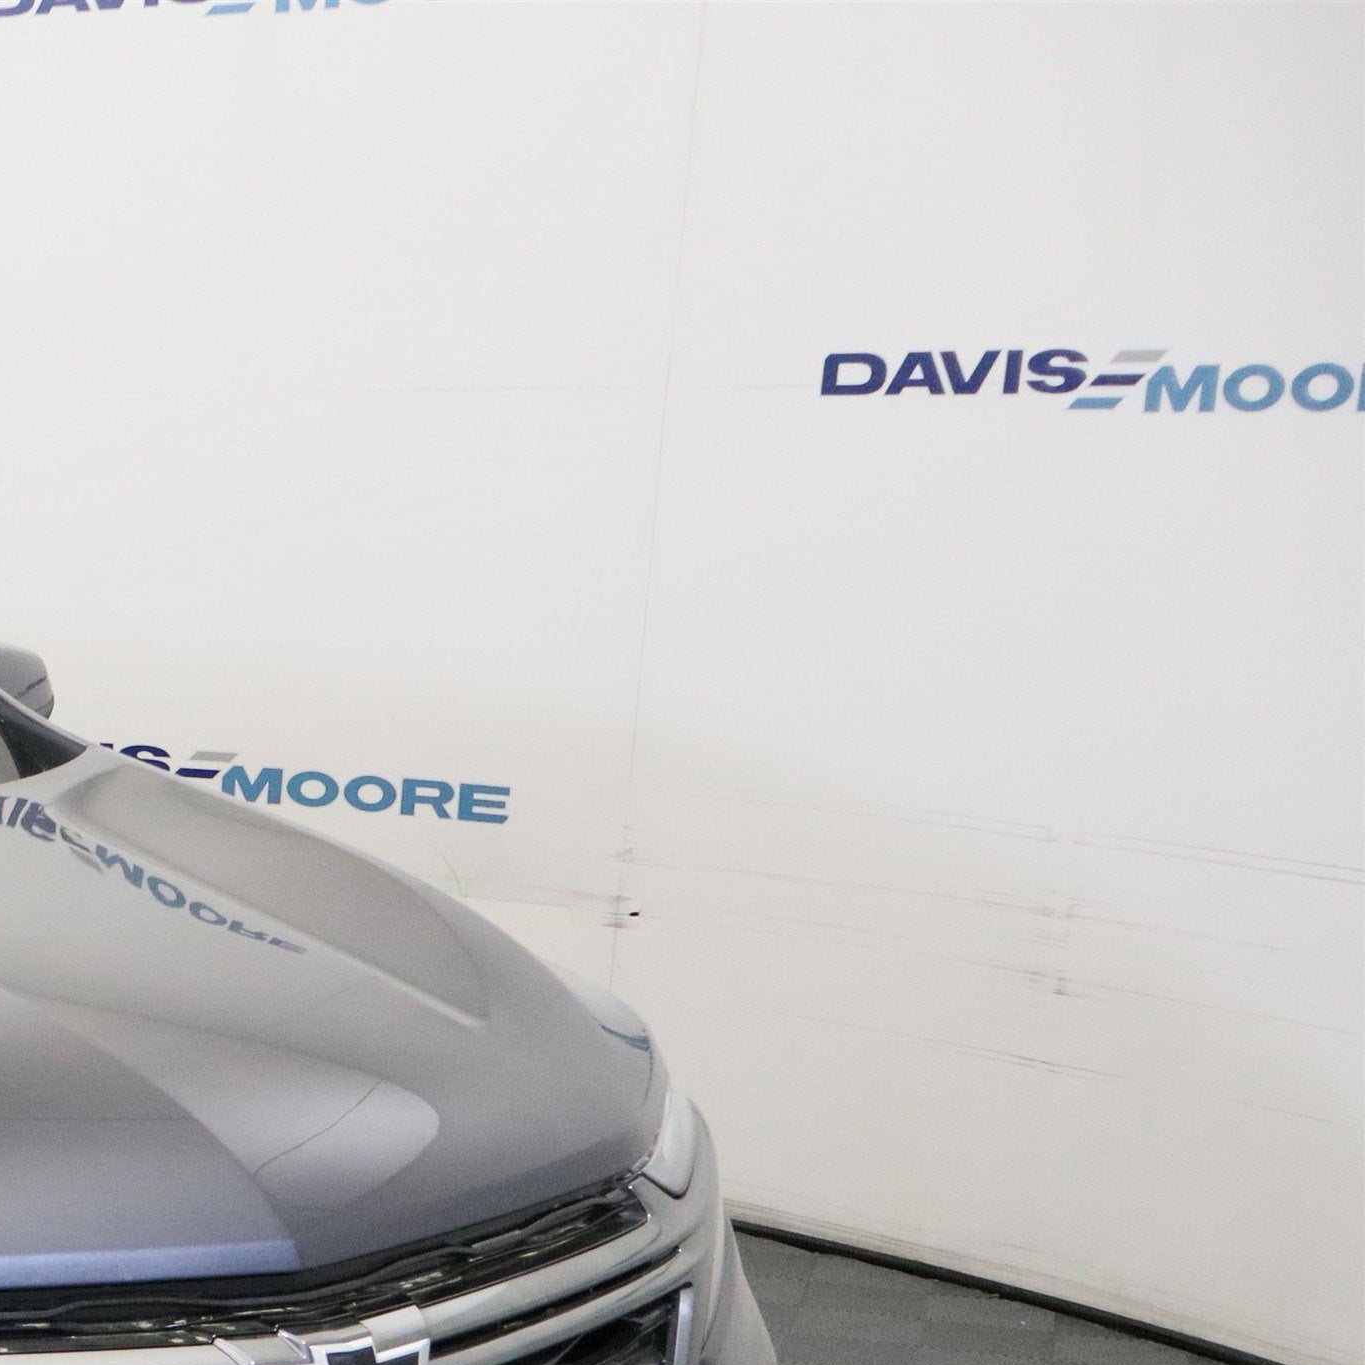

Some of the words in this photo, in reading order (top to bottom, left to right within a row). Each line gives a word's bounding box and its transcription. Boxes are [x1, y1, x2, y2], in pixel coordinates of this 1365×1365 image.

[820, 348, 1091, 397] DAVIS
[1143, 362, 1365, 414] MOO
[221, 764, 512, 824] MOORE
